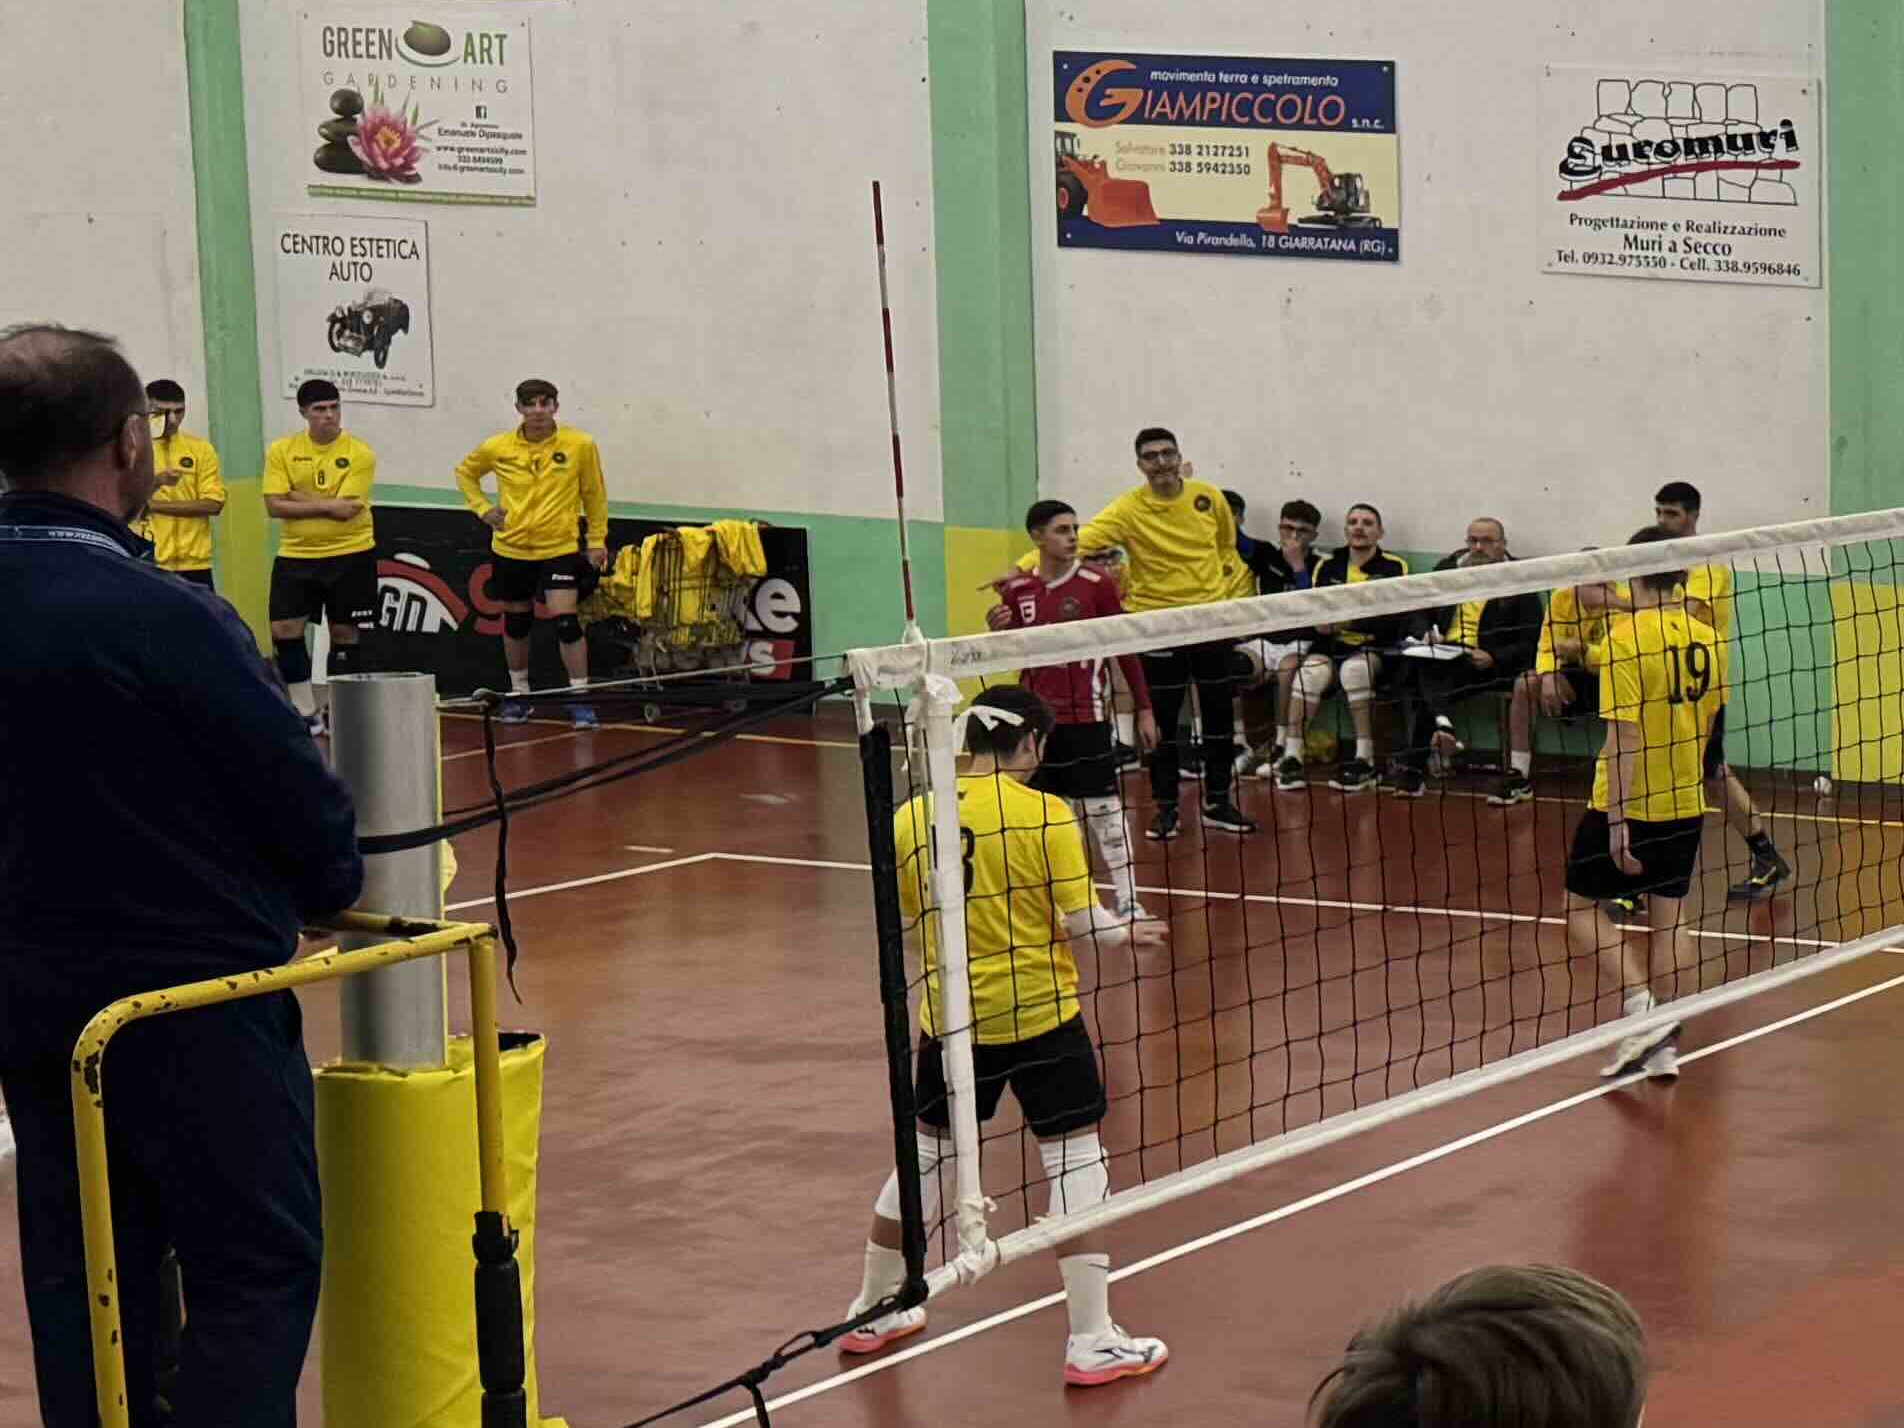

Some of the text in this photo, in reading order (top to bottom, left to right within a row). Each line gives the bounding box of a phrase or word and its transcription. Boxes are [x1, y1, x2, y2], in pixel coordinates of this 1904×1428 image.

[322, 26, 508, 65] GREEN ART
[323, 72, 508, 94] GARDENING
[1218, 71, 1248, 85] terra
[1065, 59, 1346, 128] GIAMPICCOLO
[1352, 118, 1384, 129] s.n.c.
[1169, 142, 1250, 159] 338 2127251
[1169, 160, 1192, 174] 338
[1570, 213, 1787, 238] Progettazione e Realizzazione
[281, 233, 420, 260] CENTRO ESTETICA
[1176, 231, 1386, 255] Via 18 GIARRATANA (RG)
[1623, 234, 1732, 256] Muri a Secco
[329, 261, 372, 282] AUTO
[1556, 250, 1578, 264] Tel.
[1680, 258, 1710, 272] Cell.
[1665, 642, 1710, 704] 19
